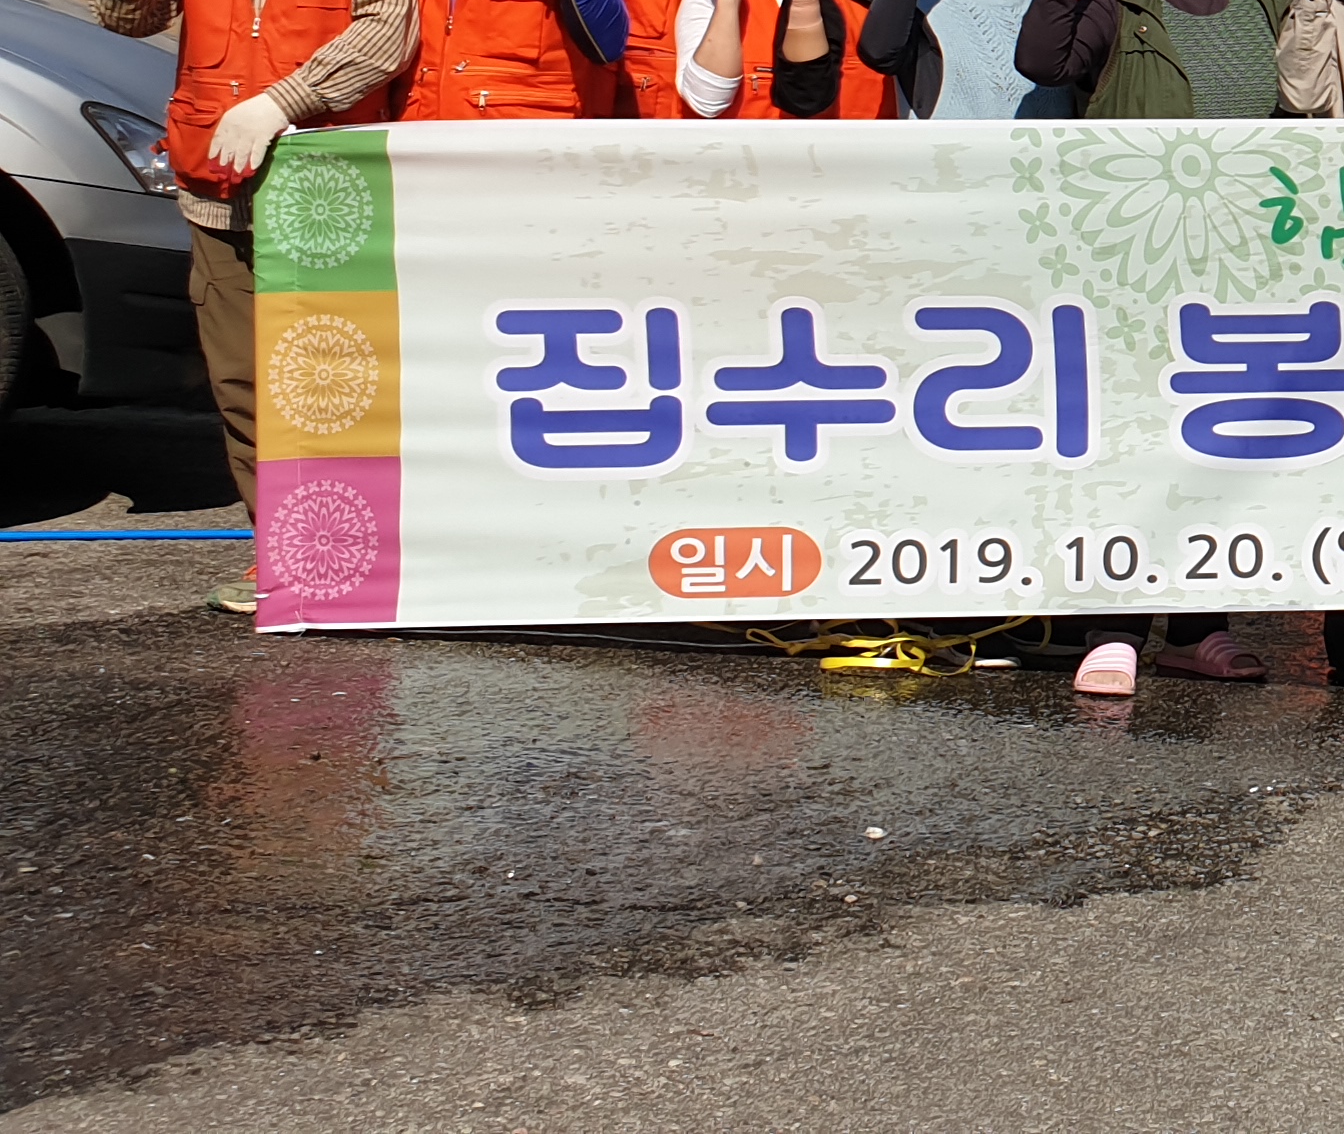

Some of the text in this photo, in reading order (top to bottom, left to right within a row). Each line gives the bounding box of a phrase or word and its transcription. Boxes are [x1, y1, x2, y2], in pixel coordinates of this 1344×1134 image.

[499, 308, 1086, 467] 집수리
[671, 534, 792, 592] 일시
[850, 538, 1031, 585] 2019.
[1067, 536, 1157, 583] 10.
[1186, 534, 1281, 580] 20.
